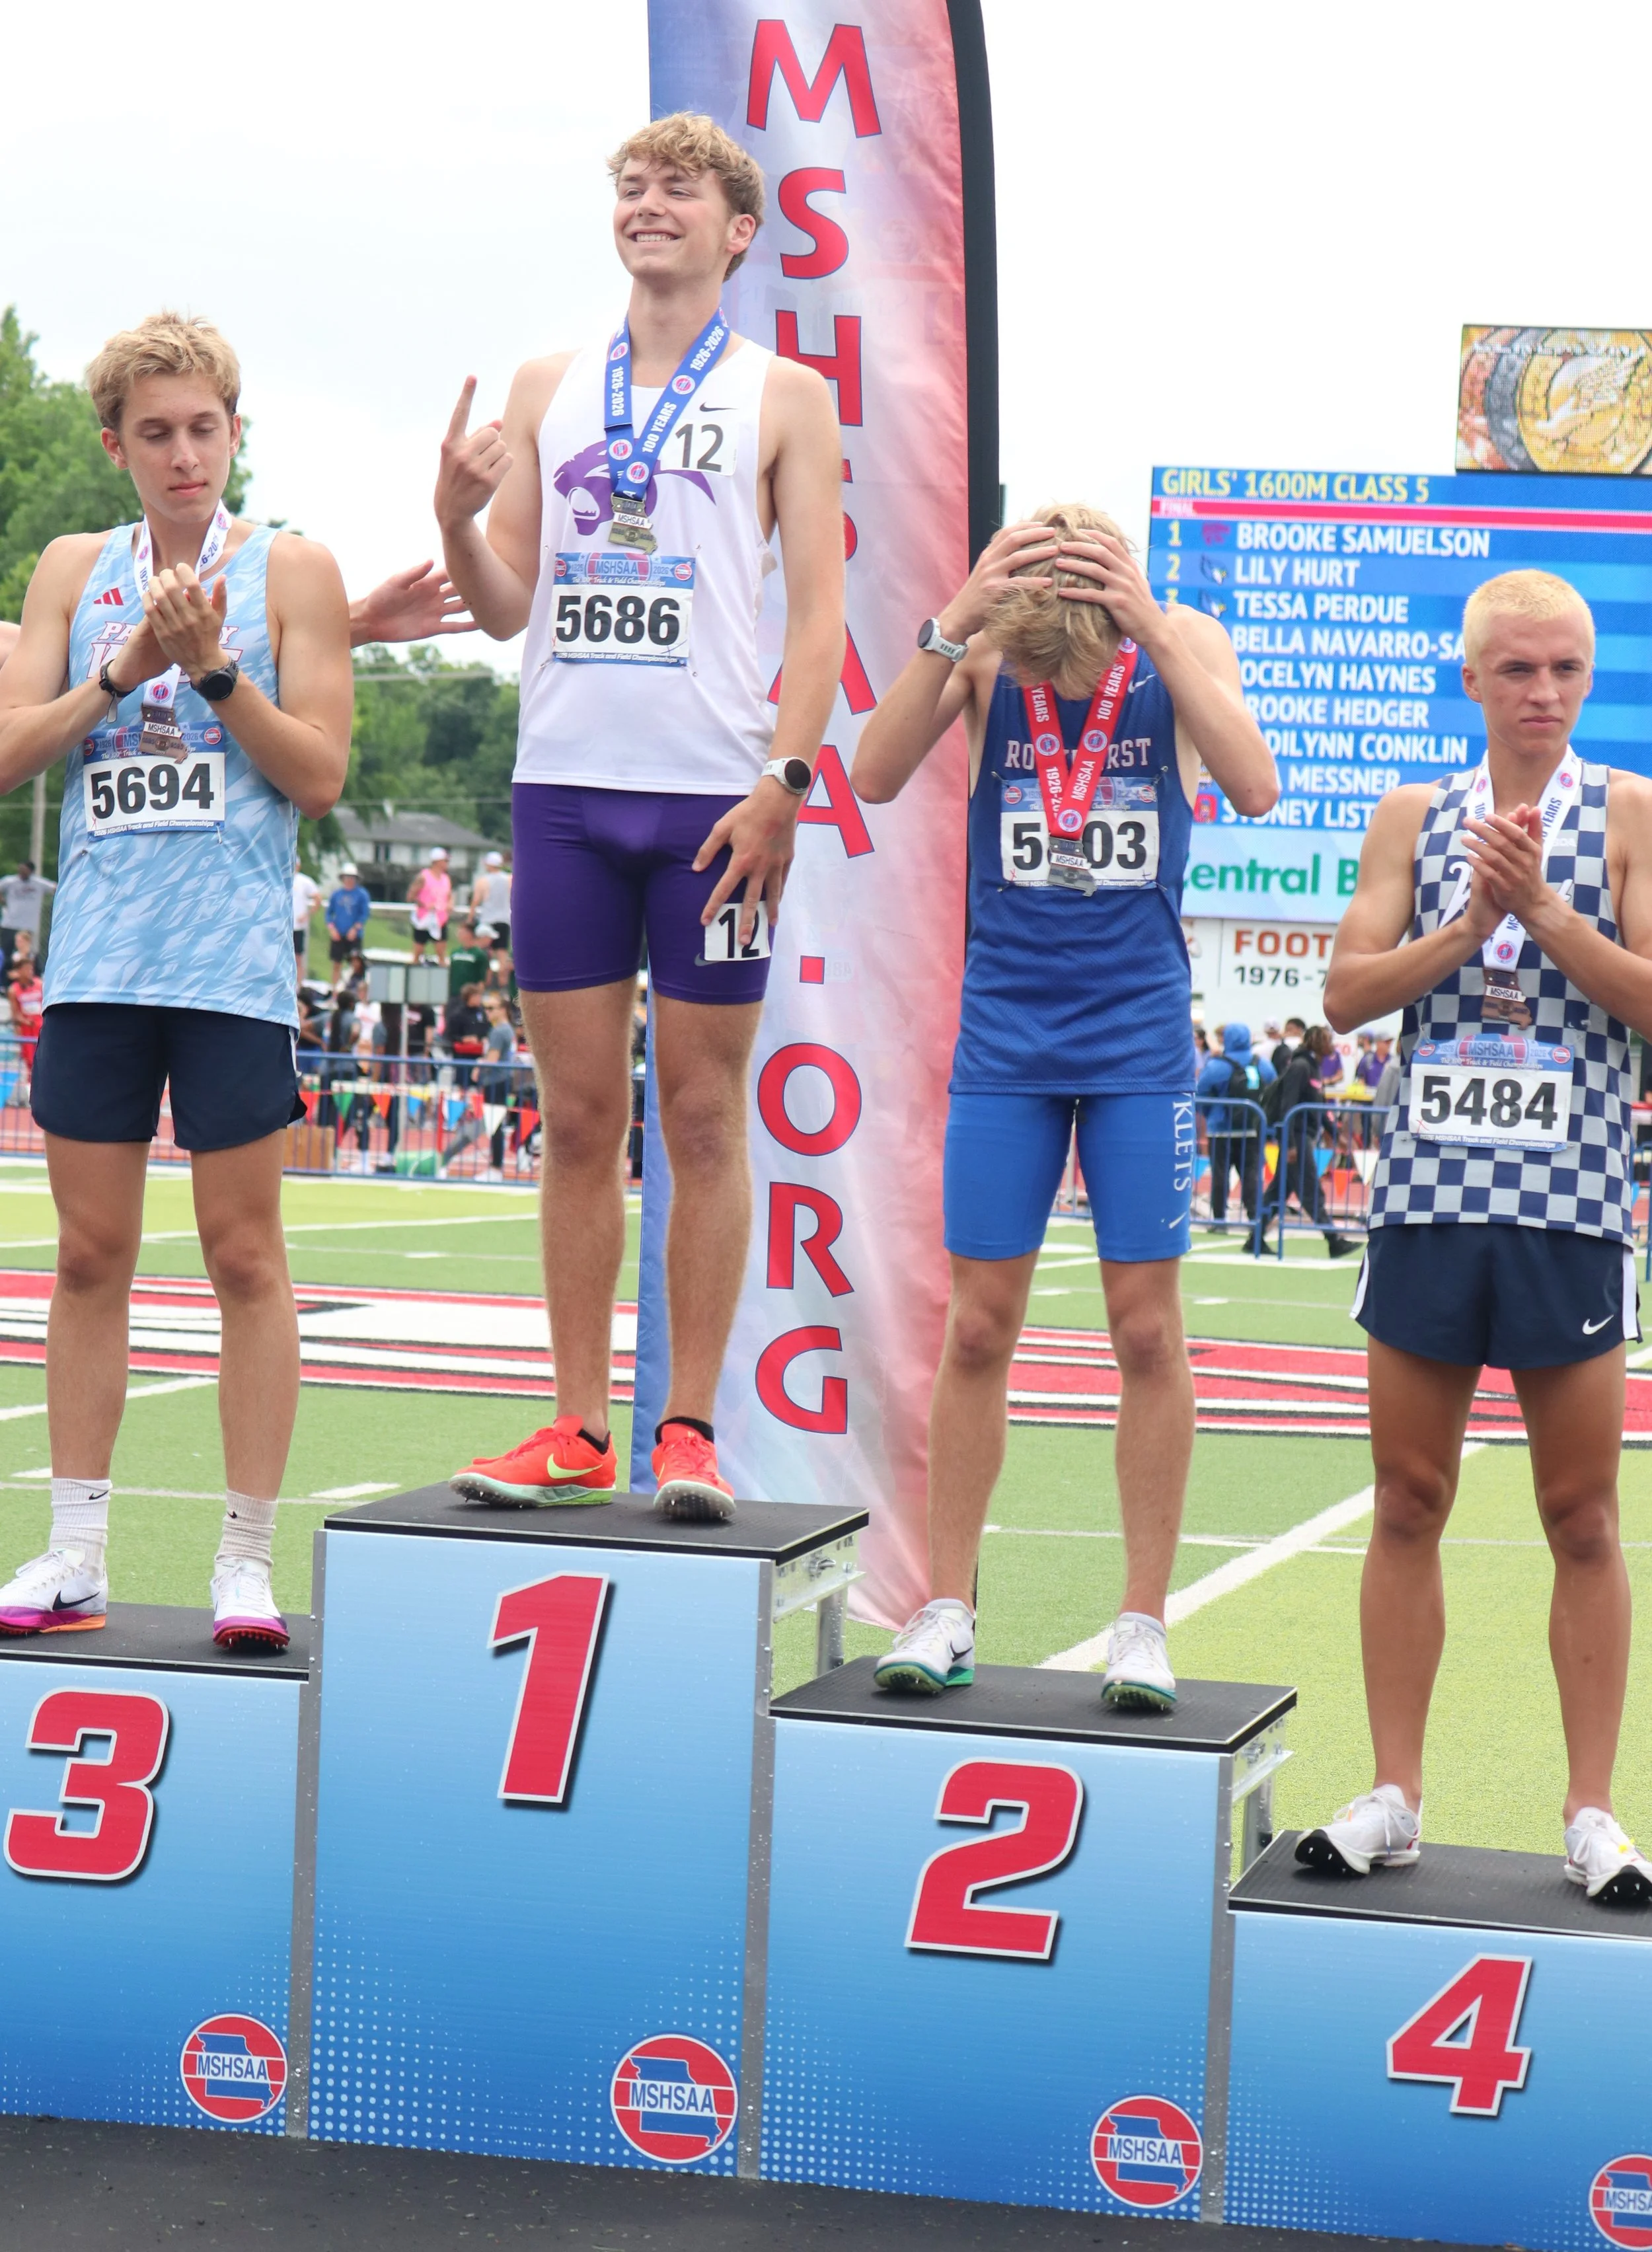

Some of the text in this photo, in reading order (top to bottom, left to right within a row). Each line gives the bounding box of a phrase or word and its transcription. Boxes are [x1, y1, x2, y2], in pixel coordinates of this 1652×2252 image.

[690, 326, 725, 371] 1926-2026
[611, 365, 624, 416] 1926-2026
[642, 402, 677, 453] 100 YEARS
[675, 424, 724, 472] 12
[1162, 469, 1429, 504] GIRLS' 1600M CLASS 5
[618, 514, 646, 527] MSHSAA
[1168, 521, 1490, 558] 1 BROOKE SAMUELSON
[595, 560, 638, 575] MSHSAA
[653, 566, 670, 575] 2026
[1166, 553, 1361, 587] 2 LILY HURT
[556, 595, 681, 646] 5686
[1233, 589, 1308, 620] TESSA
[1314, 592, 1409, 623] PERDUE
[1232, 624, 1306, 655] BELLA
[632, 654, 678, 663] Championships
[1096, 663, 1126, 720] 100 YEARS
[1240, 659, 1436, 694] OCELYN HAYNES
[1031, 687, 1050, 723] YEARS
[1245, 693, 1429, 729] ROOKE HEDGER
[147, 724, 175, 736] MSHSAA
[182, 732, 198, 741] 2026
[1263, 728, 1468, 765] DILYNN CONKLIN
[1004, 737, 1151, 770] RORST
[91, 763, 214, 819] 5694
[1070, 761, 1096, 801] MSHSAA
[1289, 764, 1401, 796] MESSNER
[1222, 798, 1320, 827] SNEY
[1542, 797, 1562, 829] YEARS
[94, 829, 107, 837] 2026
[107, 825, 128, 835] MSHSAA
[1012, 820, 1147, 871] 503
[1055, 856, 1084, 868] MSHSAA
[1184, 853, 1321, 895] entral
[718, 909, 760, 959] 12
[1490, 987, 1519, 1000] MSHSAA
[1468, 1042, 1513, 1057] MSHSAA
[1530, 1048, 1547, 1057] 2026
[1503, 1061, 1544, 1070] Championships
[1420, 1075, 1558, 1131] 5484
[1172, 1092, 1195, 1191] KLETS
[1509, 1139, 1556, 1148] Championships
[486, 1569, 611, 1804] 1
[3, 1686, 169, 1881] 3
[903, 1757, 1084, 1961] 2
[1386, 1952, 1534, 2117] 4
[196, 2053, 268, 2080] MSHSAA
[630, 2080, 715, 2115] MSHSAA
[1108, 2136, 1183, 2166] MSHSAA
[1606, 2190, 1652, 2212] MSHS
